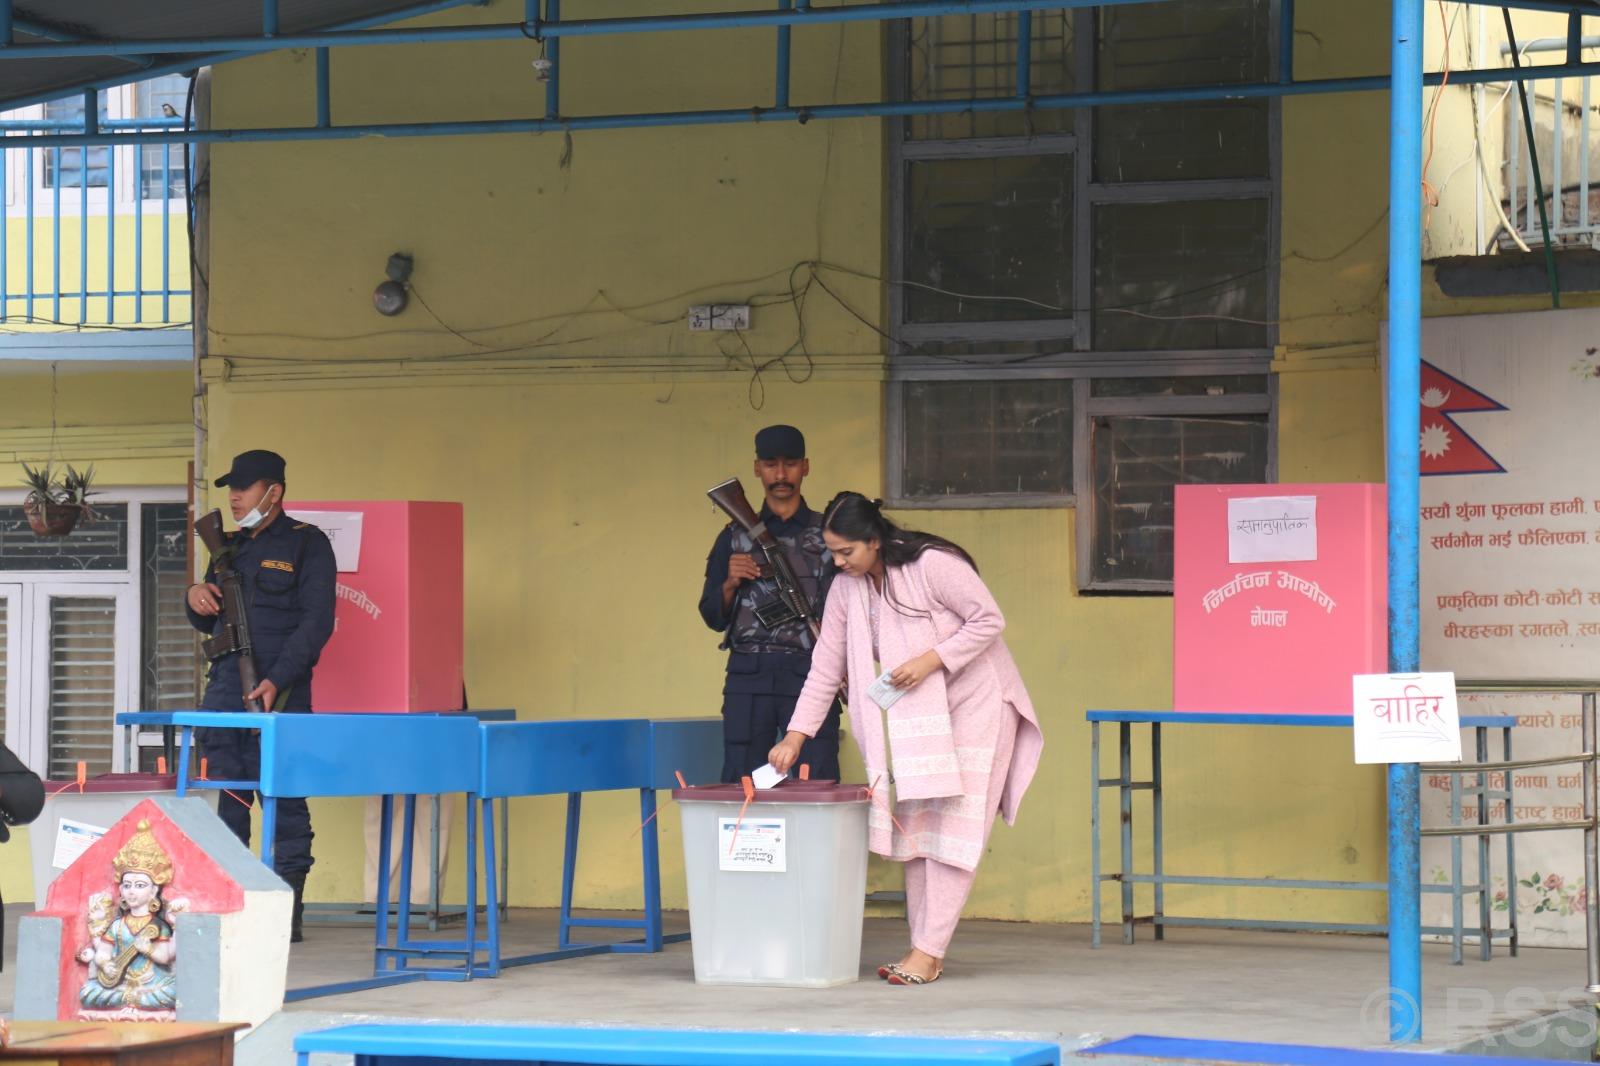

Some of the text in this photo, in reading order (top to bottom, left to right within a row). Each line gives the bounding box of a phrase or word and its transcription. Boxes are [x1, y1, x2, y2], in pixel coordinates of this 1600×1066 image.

[1492, 502, 1544, 521] फूलका
[1489, 530, 1512, 548] भई
[1202, 570, 1337, 614] निर्वाचन आयोग
[1436, 591, 1498, 611] प्रकृतिका
[1250, 606, 1288, 627] नेपाल
[1370, 684, 1445, 725] बाहिर
